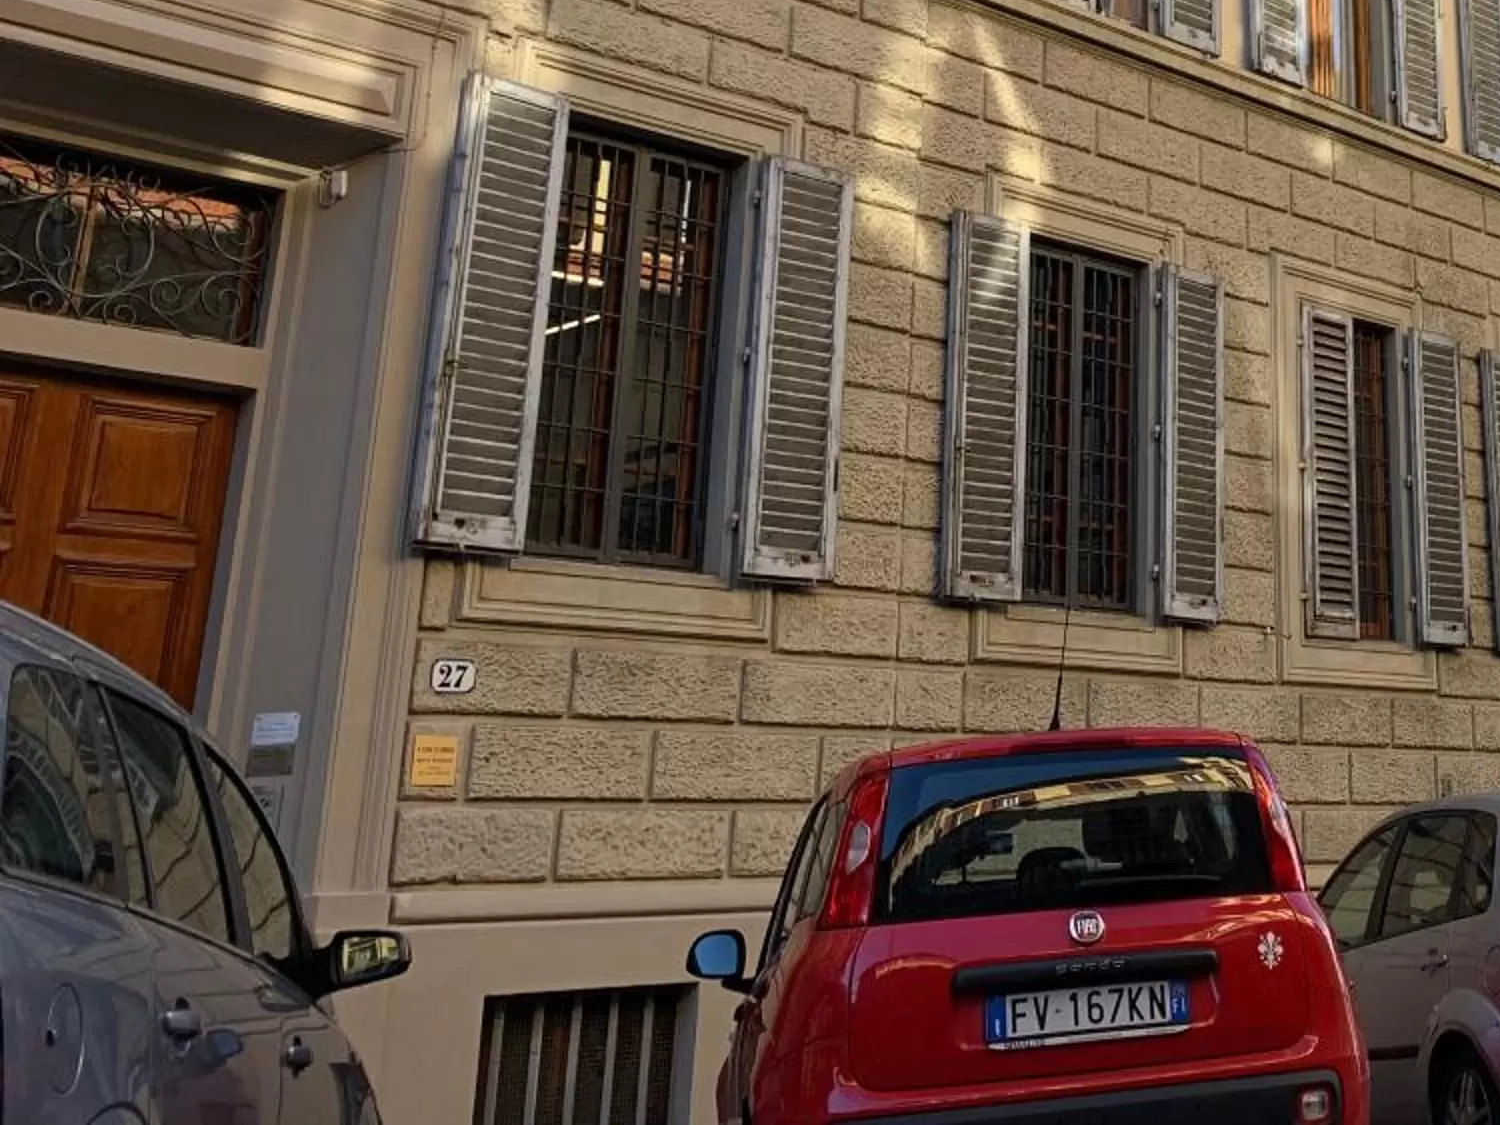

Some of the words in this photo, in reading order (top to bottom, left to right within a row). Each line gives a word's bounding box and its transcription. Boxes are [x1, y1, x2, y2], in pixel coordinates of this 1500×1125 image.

[437, 664, 469, 688] 27
[1011, 995, 1049, 1034] FV
[1069, 983, 1167, 1027] 167KN
